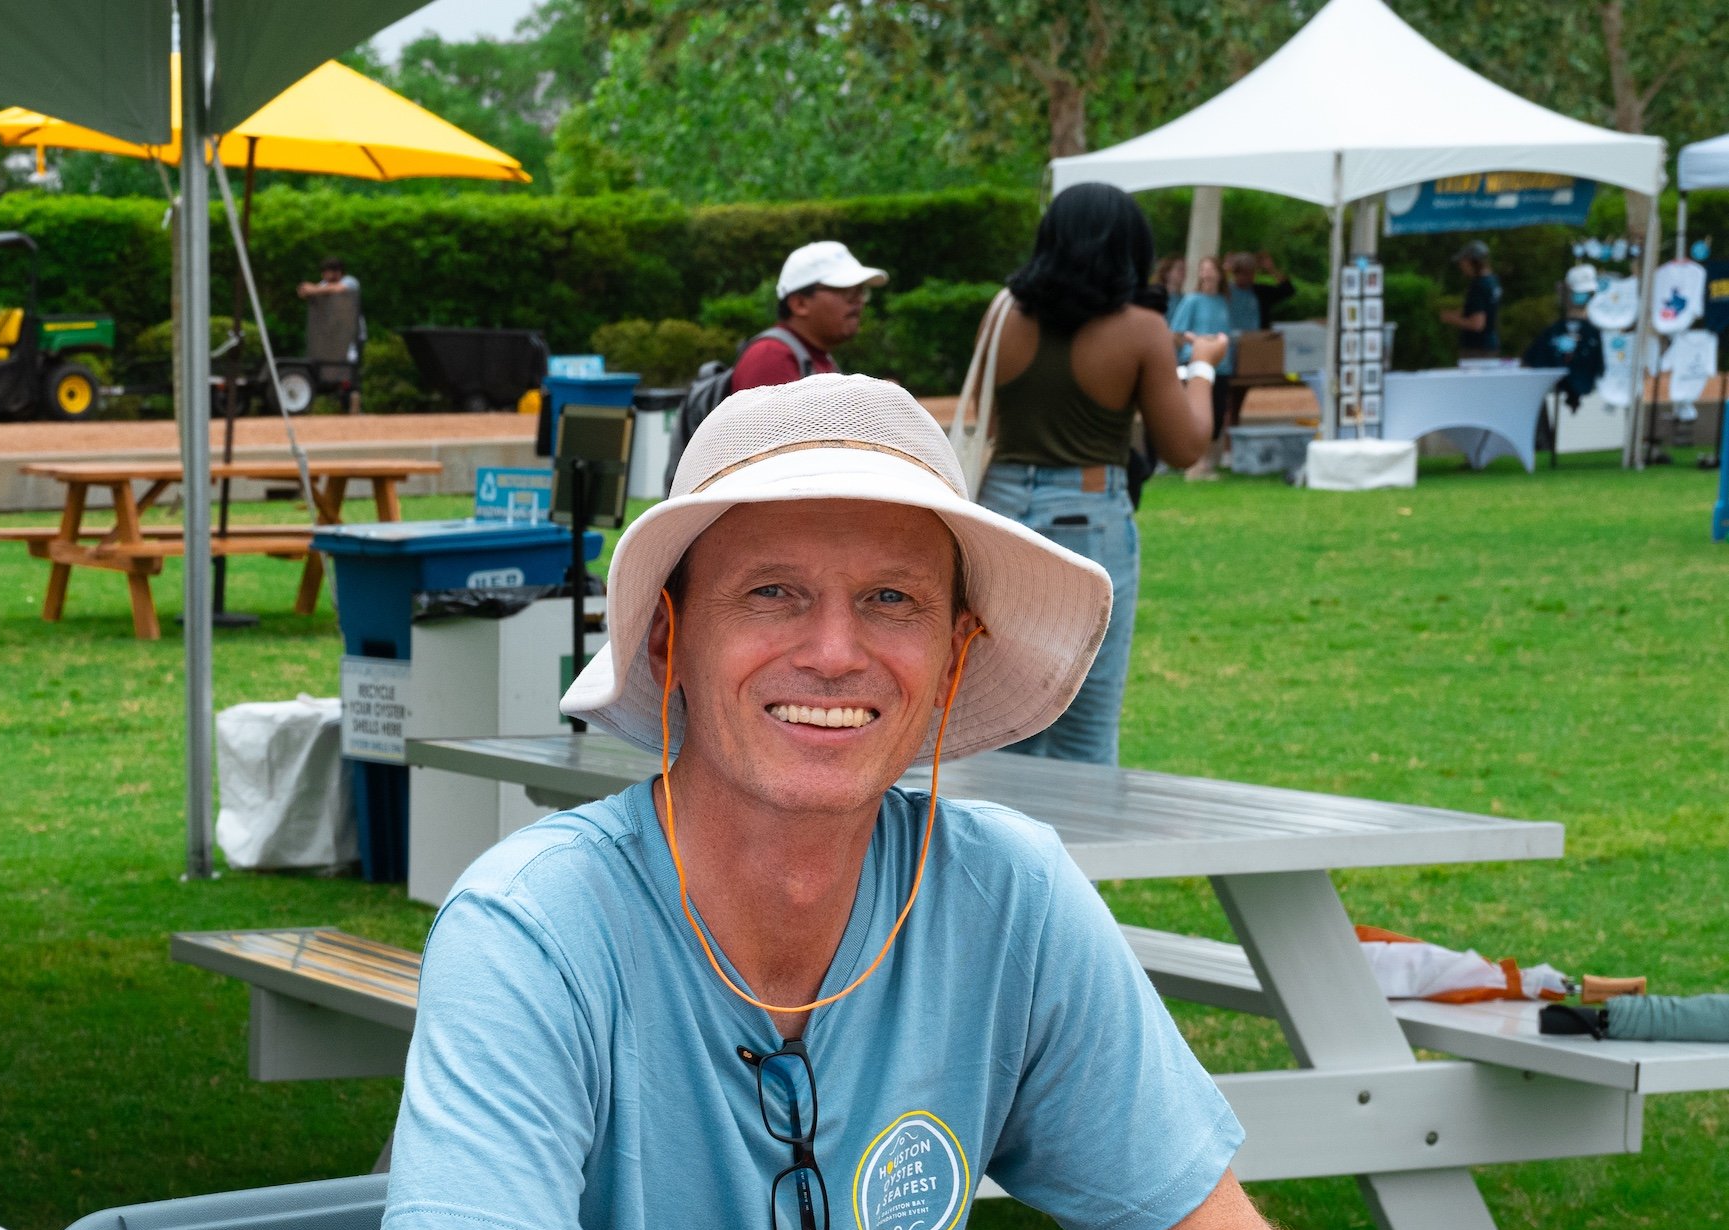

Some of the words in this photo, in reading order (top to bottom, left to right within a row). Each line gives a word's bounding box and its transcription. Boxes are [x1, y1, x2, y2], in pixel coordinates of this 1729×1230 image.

[358, 682, 394, 700] RECYCLE
[350, 701, 371, 715] YOUR
[374, 702, 405, 719] OYSTER
[352, 718, 379, 735] SHELLS
[382, 721, 402, 737] HERE
[879, 1138, 931, 1179] HOUSTON
[883, 1160, 923, 1192] OYSTER
[882, 1176, 937, 1207] SEAFEST
[909, 1207, 929, 1215] EVENT
